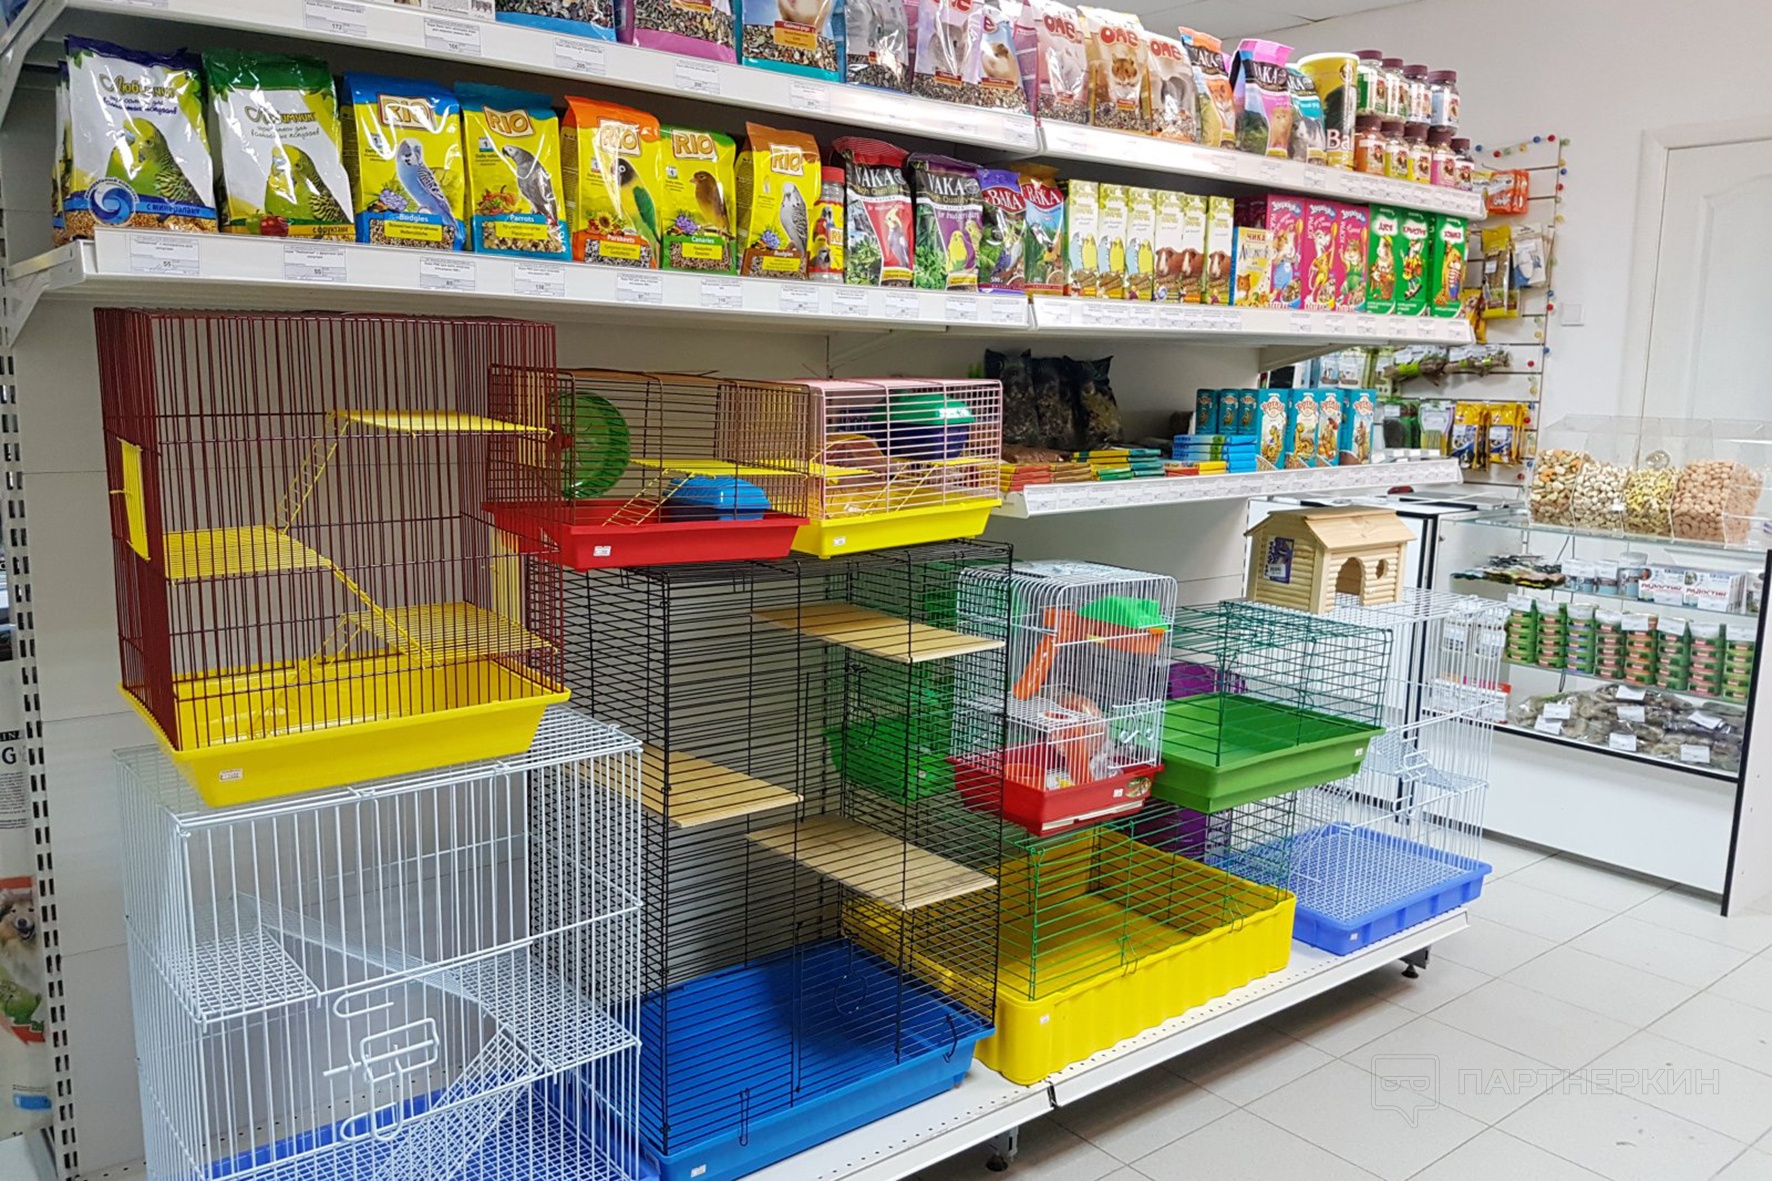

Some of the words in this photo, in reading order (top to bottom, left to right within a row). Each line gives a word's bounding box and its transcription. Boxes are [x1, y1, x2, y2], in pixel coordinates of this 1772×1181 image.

[486, 111, 530, 134] RIO
[675, 132, 715, 156] RIO
[772, 147, 801, 172] RIO
[854, 164, 896, 188] VAKA
[927, 173, 966, 196] VAKA
[509, 213, 535, 223] Parrots
